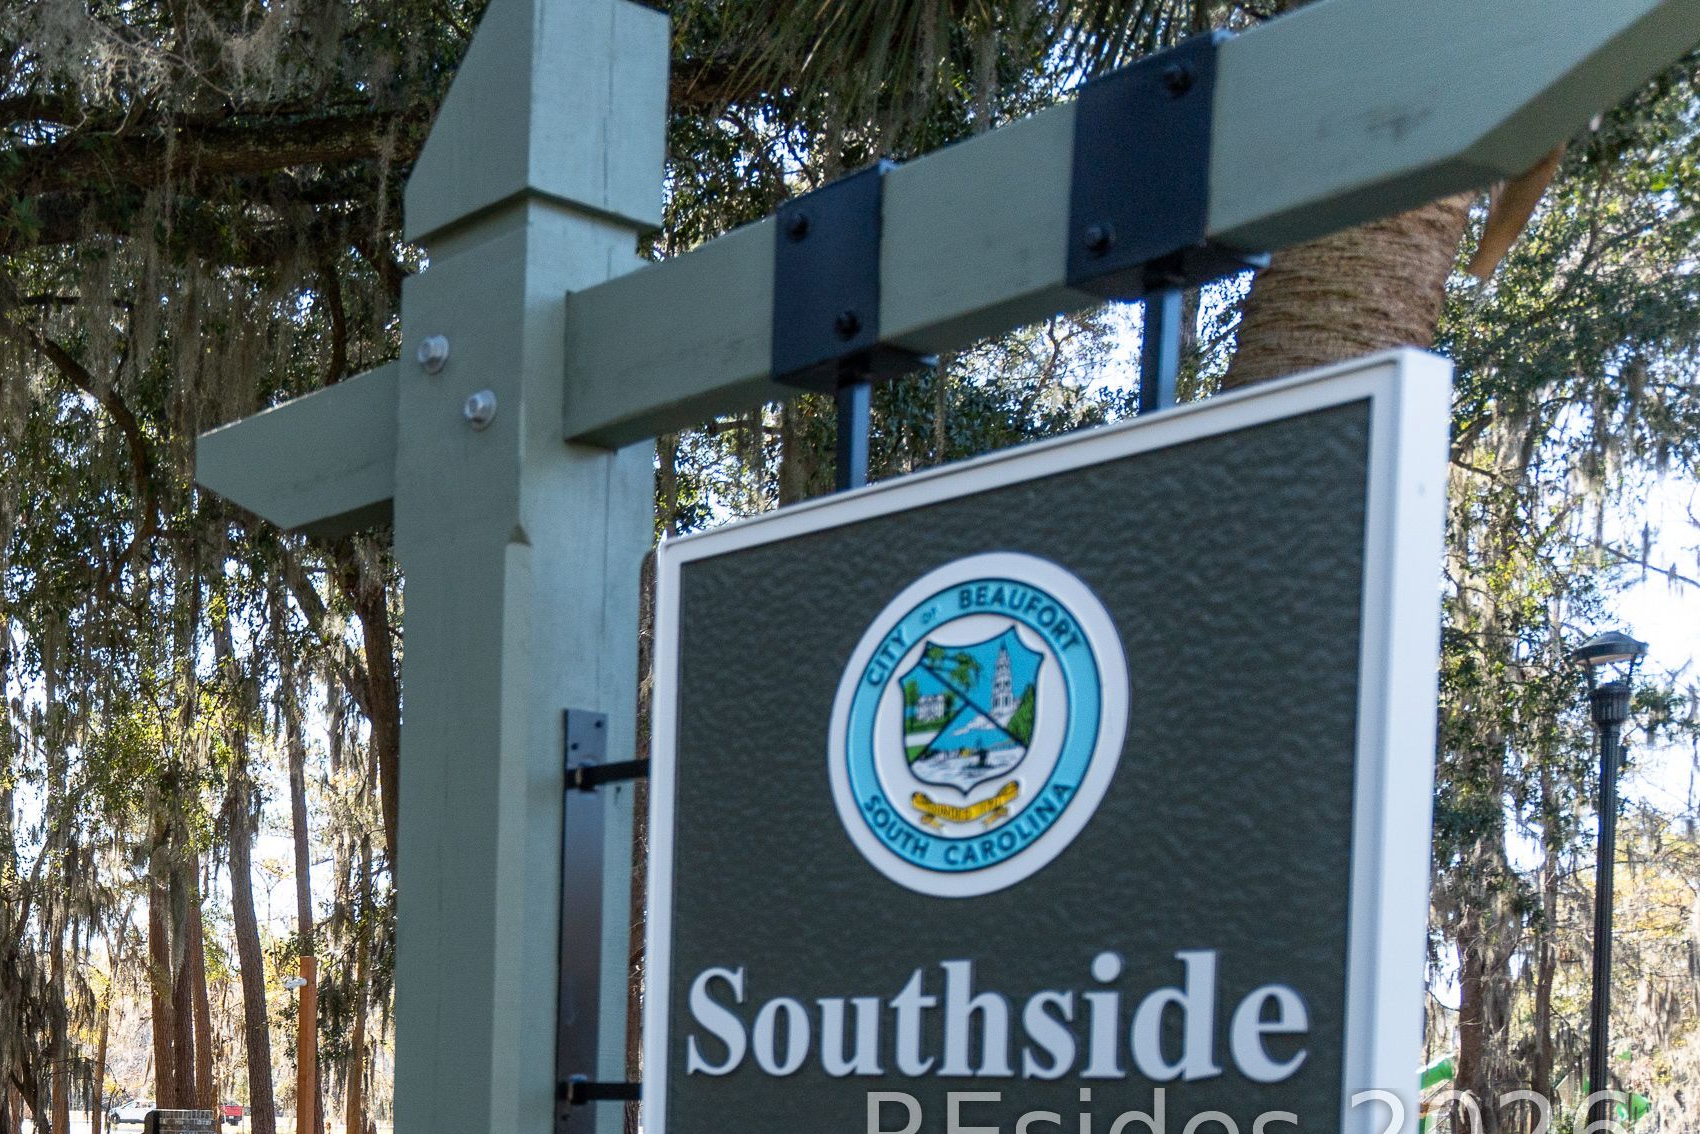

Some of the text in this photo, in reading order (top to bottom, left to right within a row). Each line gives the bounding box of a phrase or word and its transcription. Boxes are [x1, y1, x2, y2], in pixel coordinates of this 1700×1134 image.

[867, 630, 908, 687] CITY
[958, 585, 1082, 650] BEAUFORT
[863, 783, 1073, 865] SOUTH CAROLINA
[687, 950, 1310, 1082] Southside
